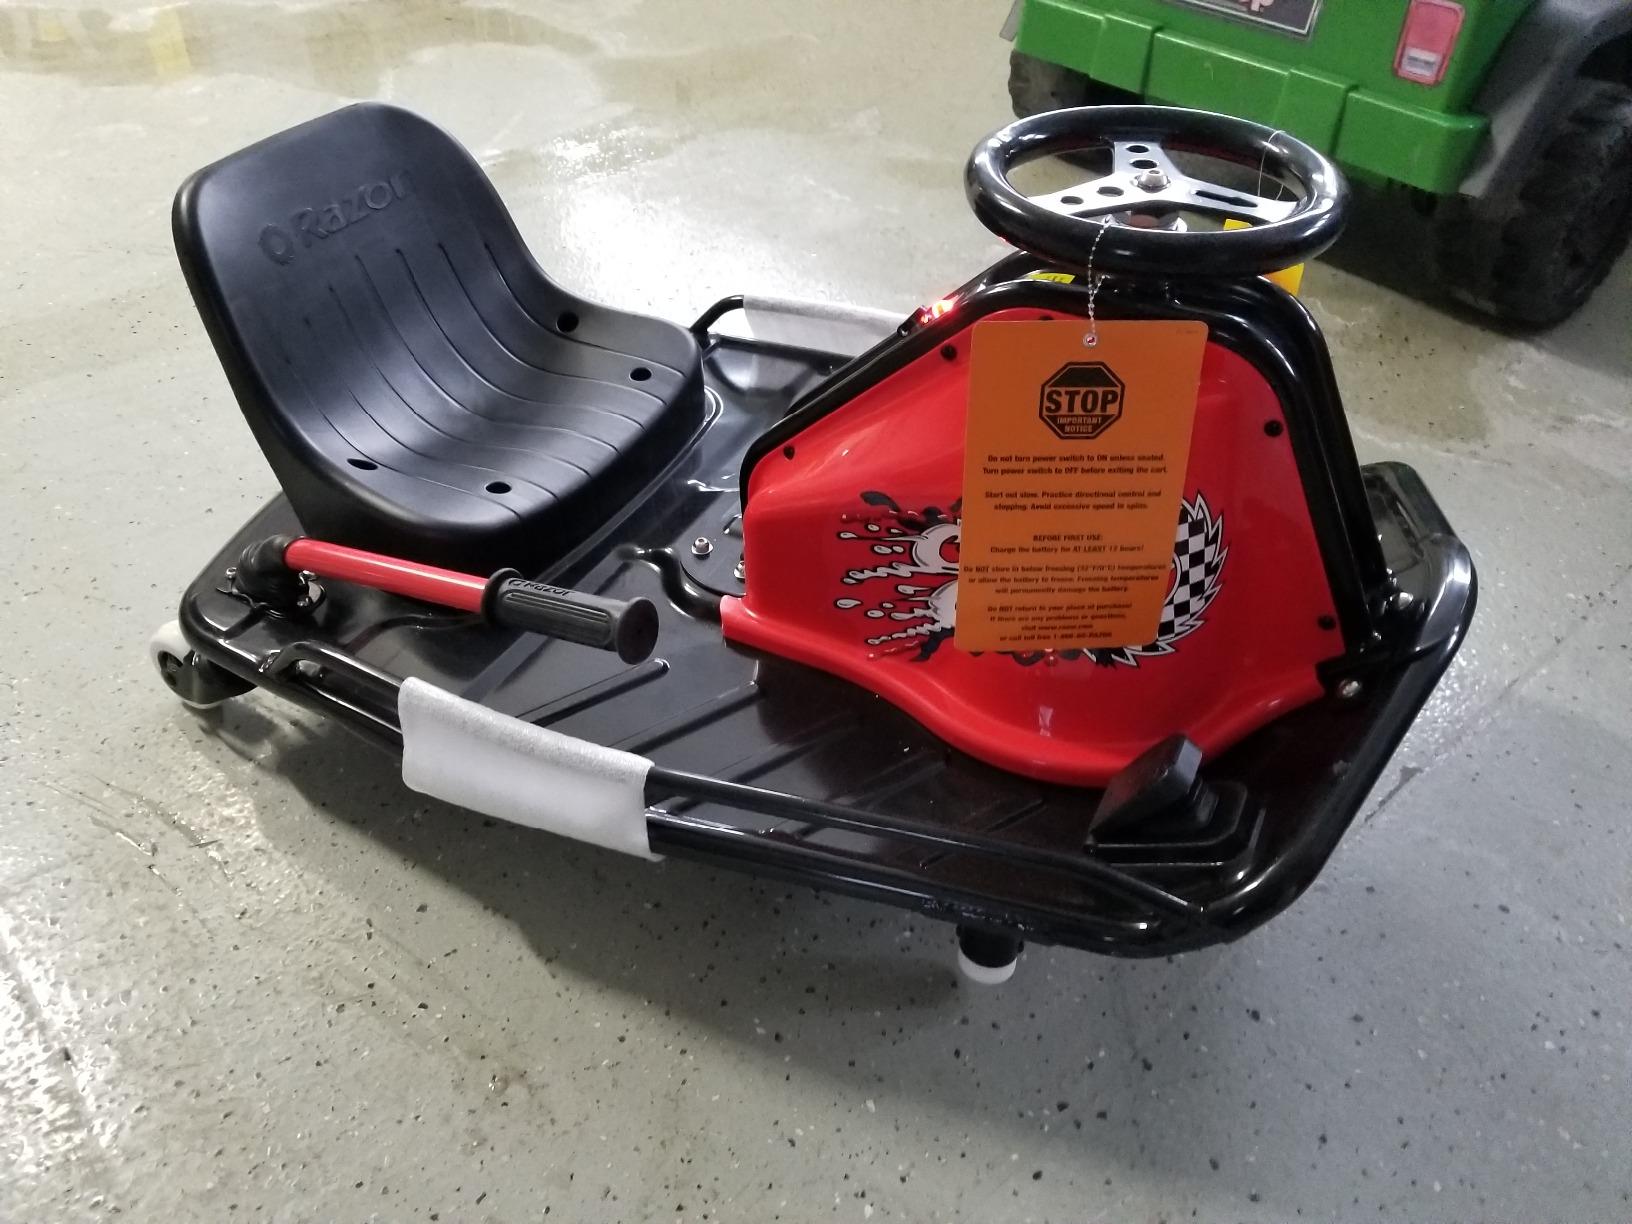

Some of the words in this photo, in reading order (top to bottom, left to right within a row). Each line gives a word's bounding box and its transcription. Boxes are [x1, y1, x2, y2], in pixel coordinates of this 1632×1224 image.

[291, 171, 411, 247] Razor
[1045, 389, 1119, 414] STOP
[1057, 416, 1101, 425] IMPORTANT
[1064, 424, 1093, 433] NOTICE
[1032, 455, 1056, 464] power
[1001, 467, 1024, 476] power
[1107, 466, 1134, 475] exiting
[1092, 503, 1115, 511] speed
[990, 546, 1016, 554] Charge
[1032, 546, 1058, 554] battery
[1045, 565, 1074, 573] freezing
[1118, 564, 1166, 572] temperatures
[1077, 575, 1108, 583] Freezing
[1110, 575, 1159, 583] temperatures
[1010, 587, 1055, 595] permanently
[1057, 586, 1086, 594] damage
[1065, 604, 1085, 612] place
[1046, 614, 1079, 622] problems
